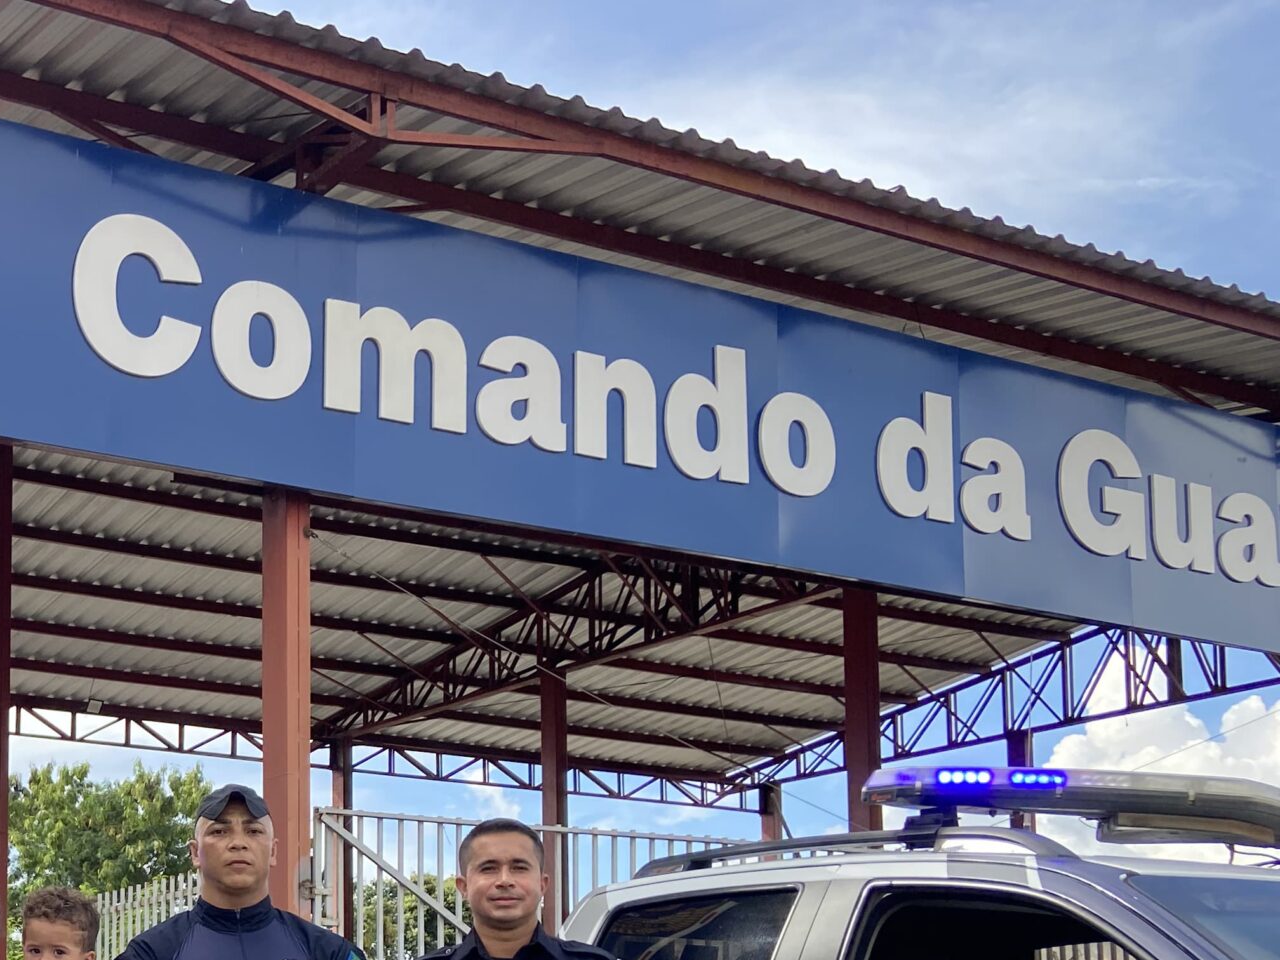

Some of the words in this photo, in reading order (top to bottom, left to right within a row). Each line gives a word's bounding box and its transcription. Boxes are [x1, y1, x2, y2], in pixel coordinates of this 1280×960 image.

[72, 212, 836, 497] Comando
[876, 391, 1032, 542] da
[1058, 429, 1280, 588] Gua
